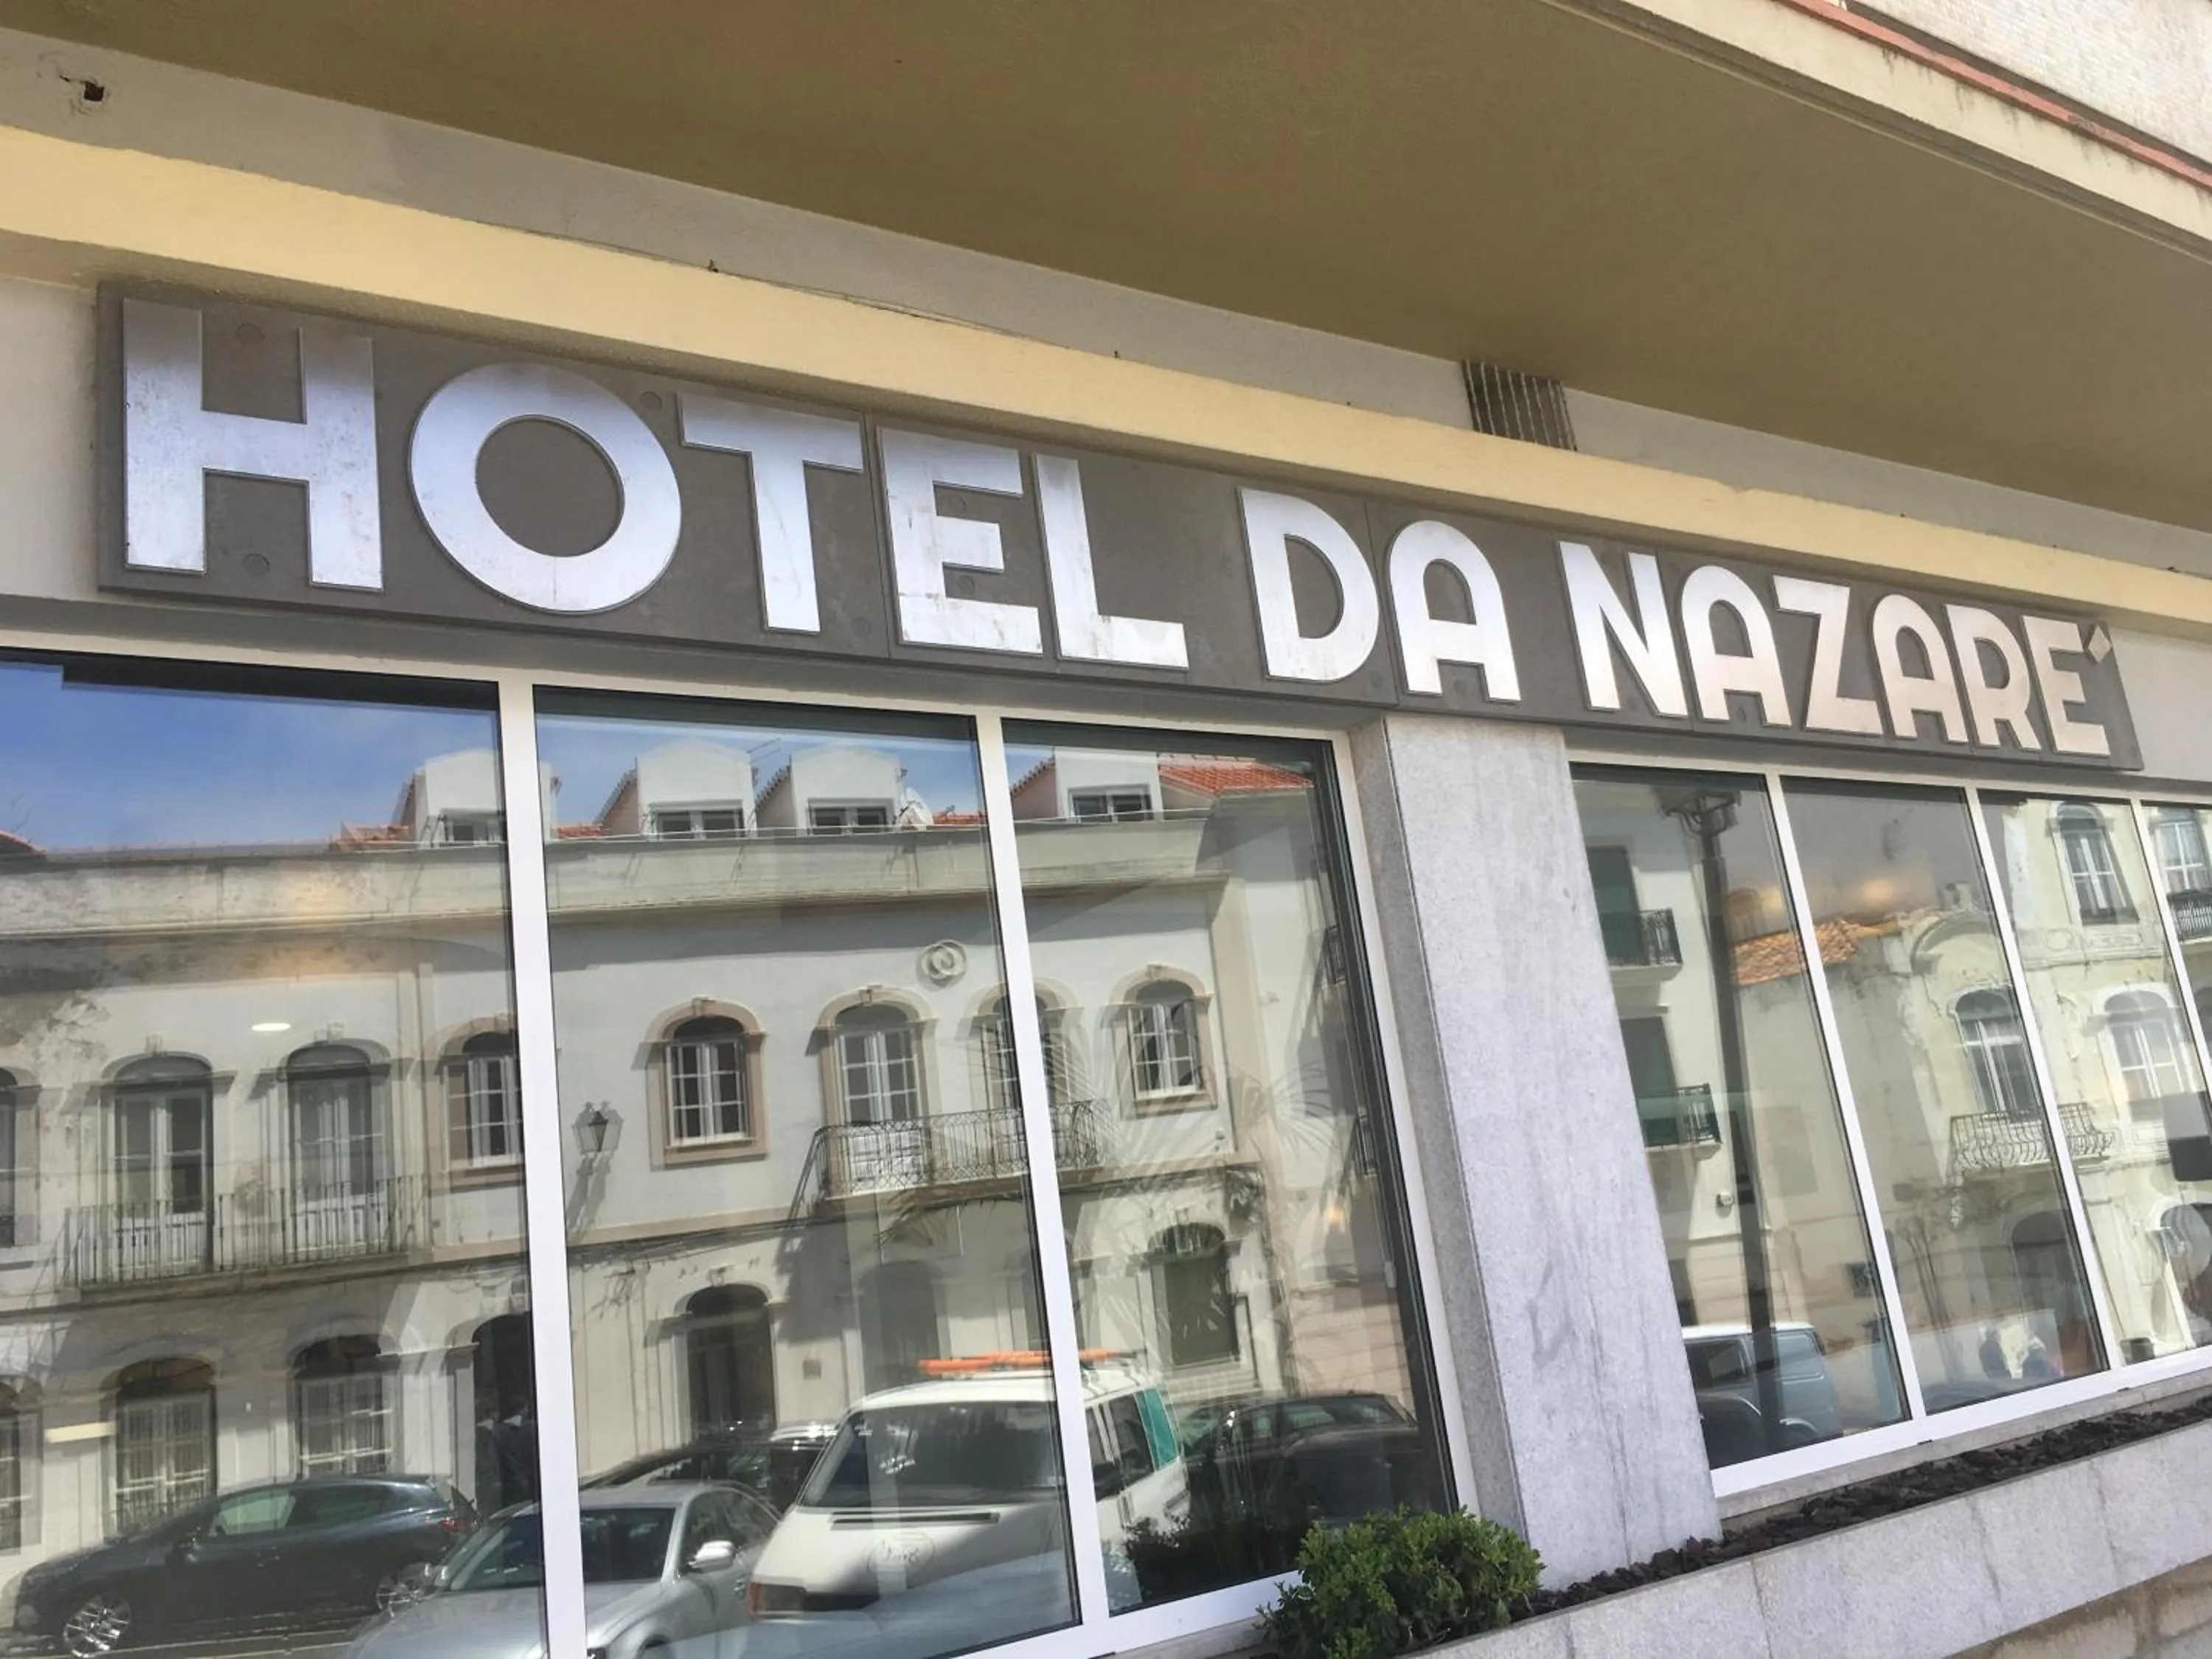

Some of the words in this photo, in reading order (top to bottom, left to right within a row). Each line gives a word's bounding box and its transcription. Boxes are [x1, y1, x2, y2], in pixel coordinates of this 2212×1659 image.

[123, 298, 1189, 669] HOTEL
[1239, 487, 1523, 705] DA
[1557, 540, 2113, 757] NAZARÉ
